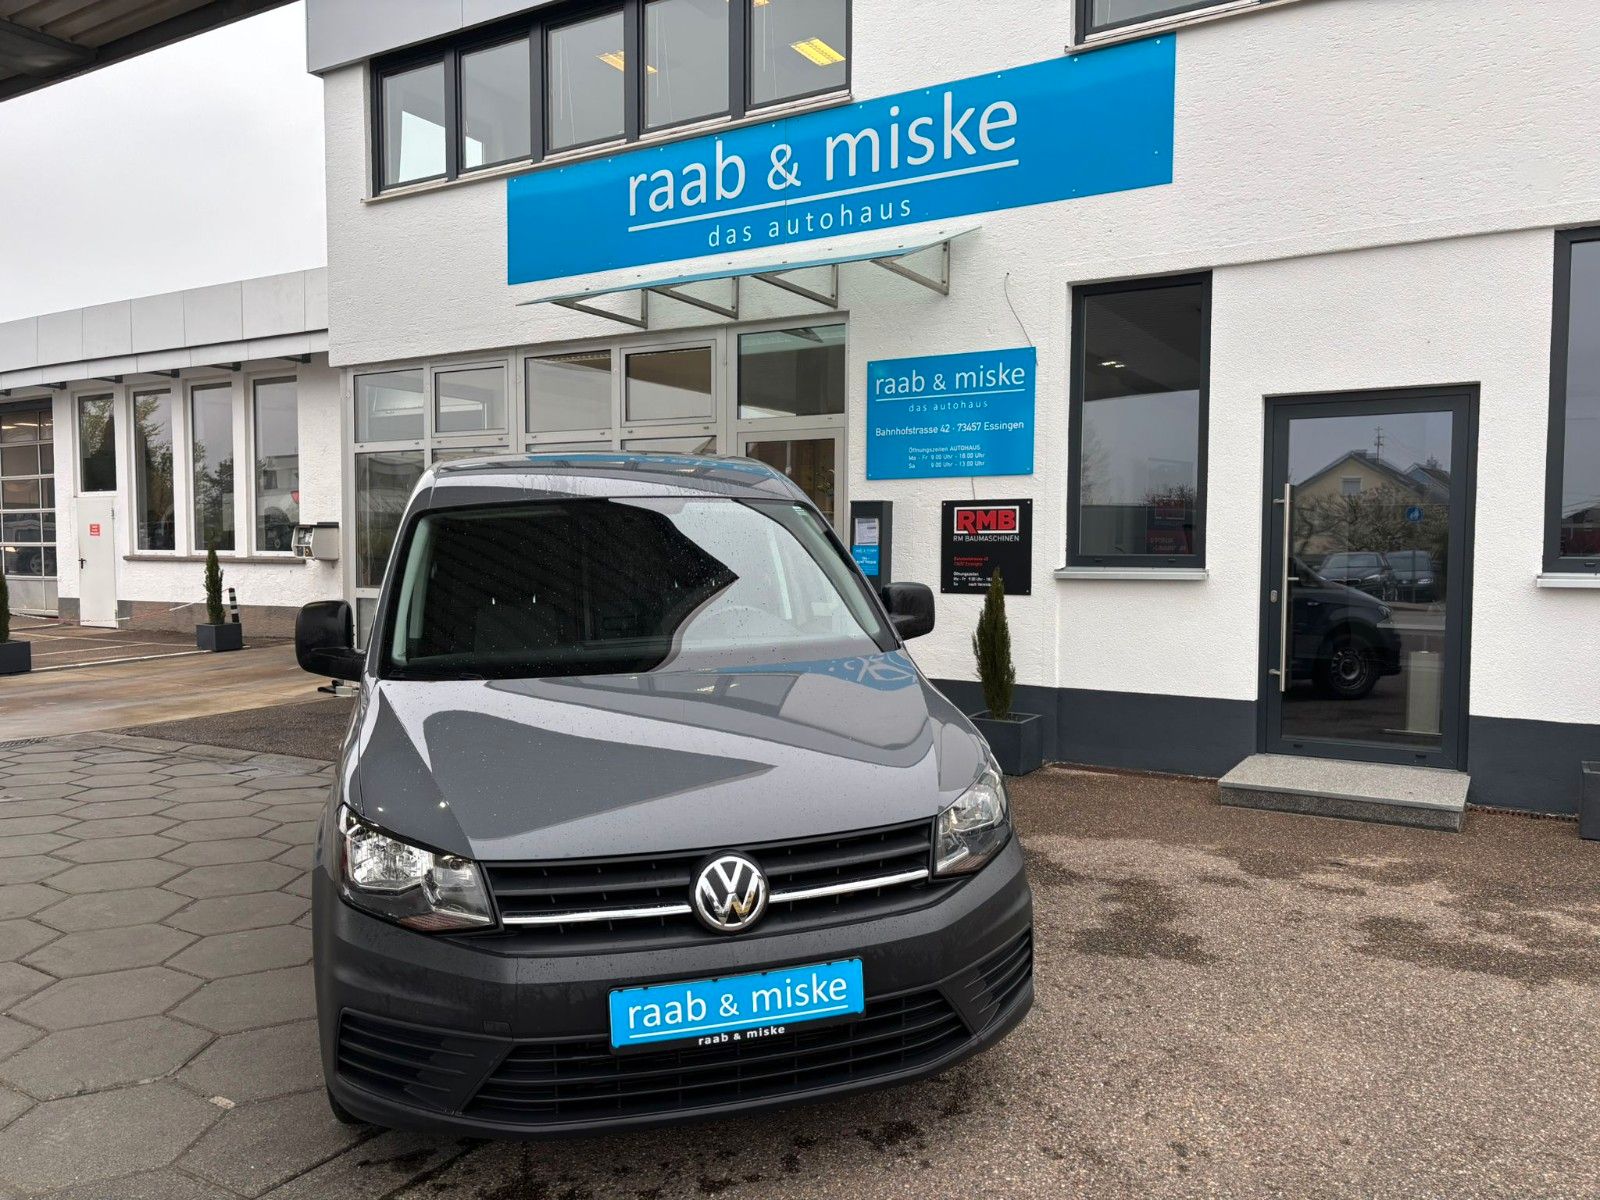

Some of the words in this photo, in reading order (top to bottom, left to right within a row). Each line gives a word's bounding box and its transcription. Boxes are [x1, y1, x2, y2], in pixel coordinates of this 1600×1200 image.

[627, 139, 746, 217] raab
[767, 142, 802, 191] &
[825, 90, 1018, 181] miske
[708, 219, 752, 248] das
[768, 196, 912, 238] autohaus
[875, 369, 925, 395] raab
[933, 373, 946, 390] &
[955, 362, 1025, 389] miske
[908, 403, 927, 412] das
[933, 400, 988, 411] autohaus
[875, 425, 938, 437] Bahnhofstrasse
[940, 424, 950, 433] 42
[957, 422, 981, 432] 73457
[984, 421, 1024, 432] Essingen
[957, 509, 1016, 535] RMB
[629, 990, 707, 1029] raab
[719, 993, 739, 1017] &
[752, 973, 847, 1012] miske
[698, 1033, 728, 1045] raab
[733, 1032, 741, 1040] &
[747, 1025, 785, 1039] miske
